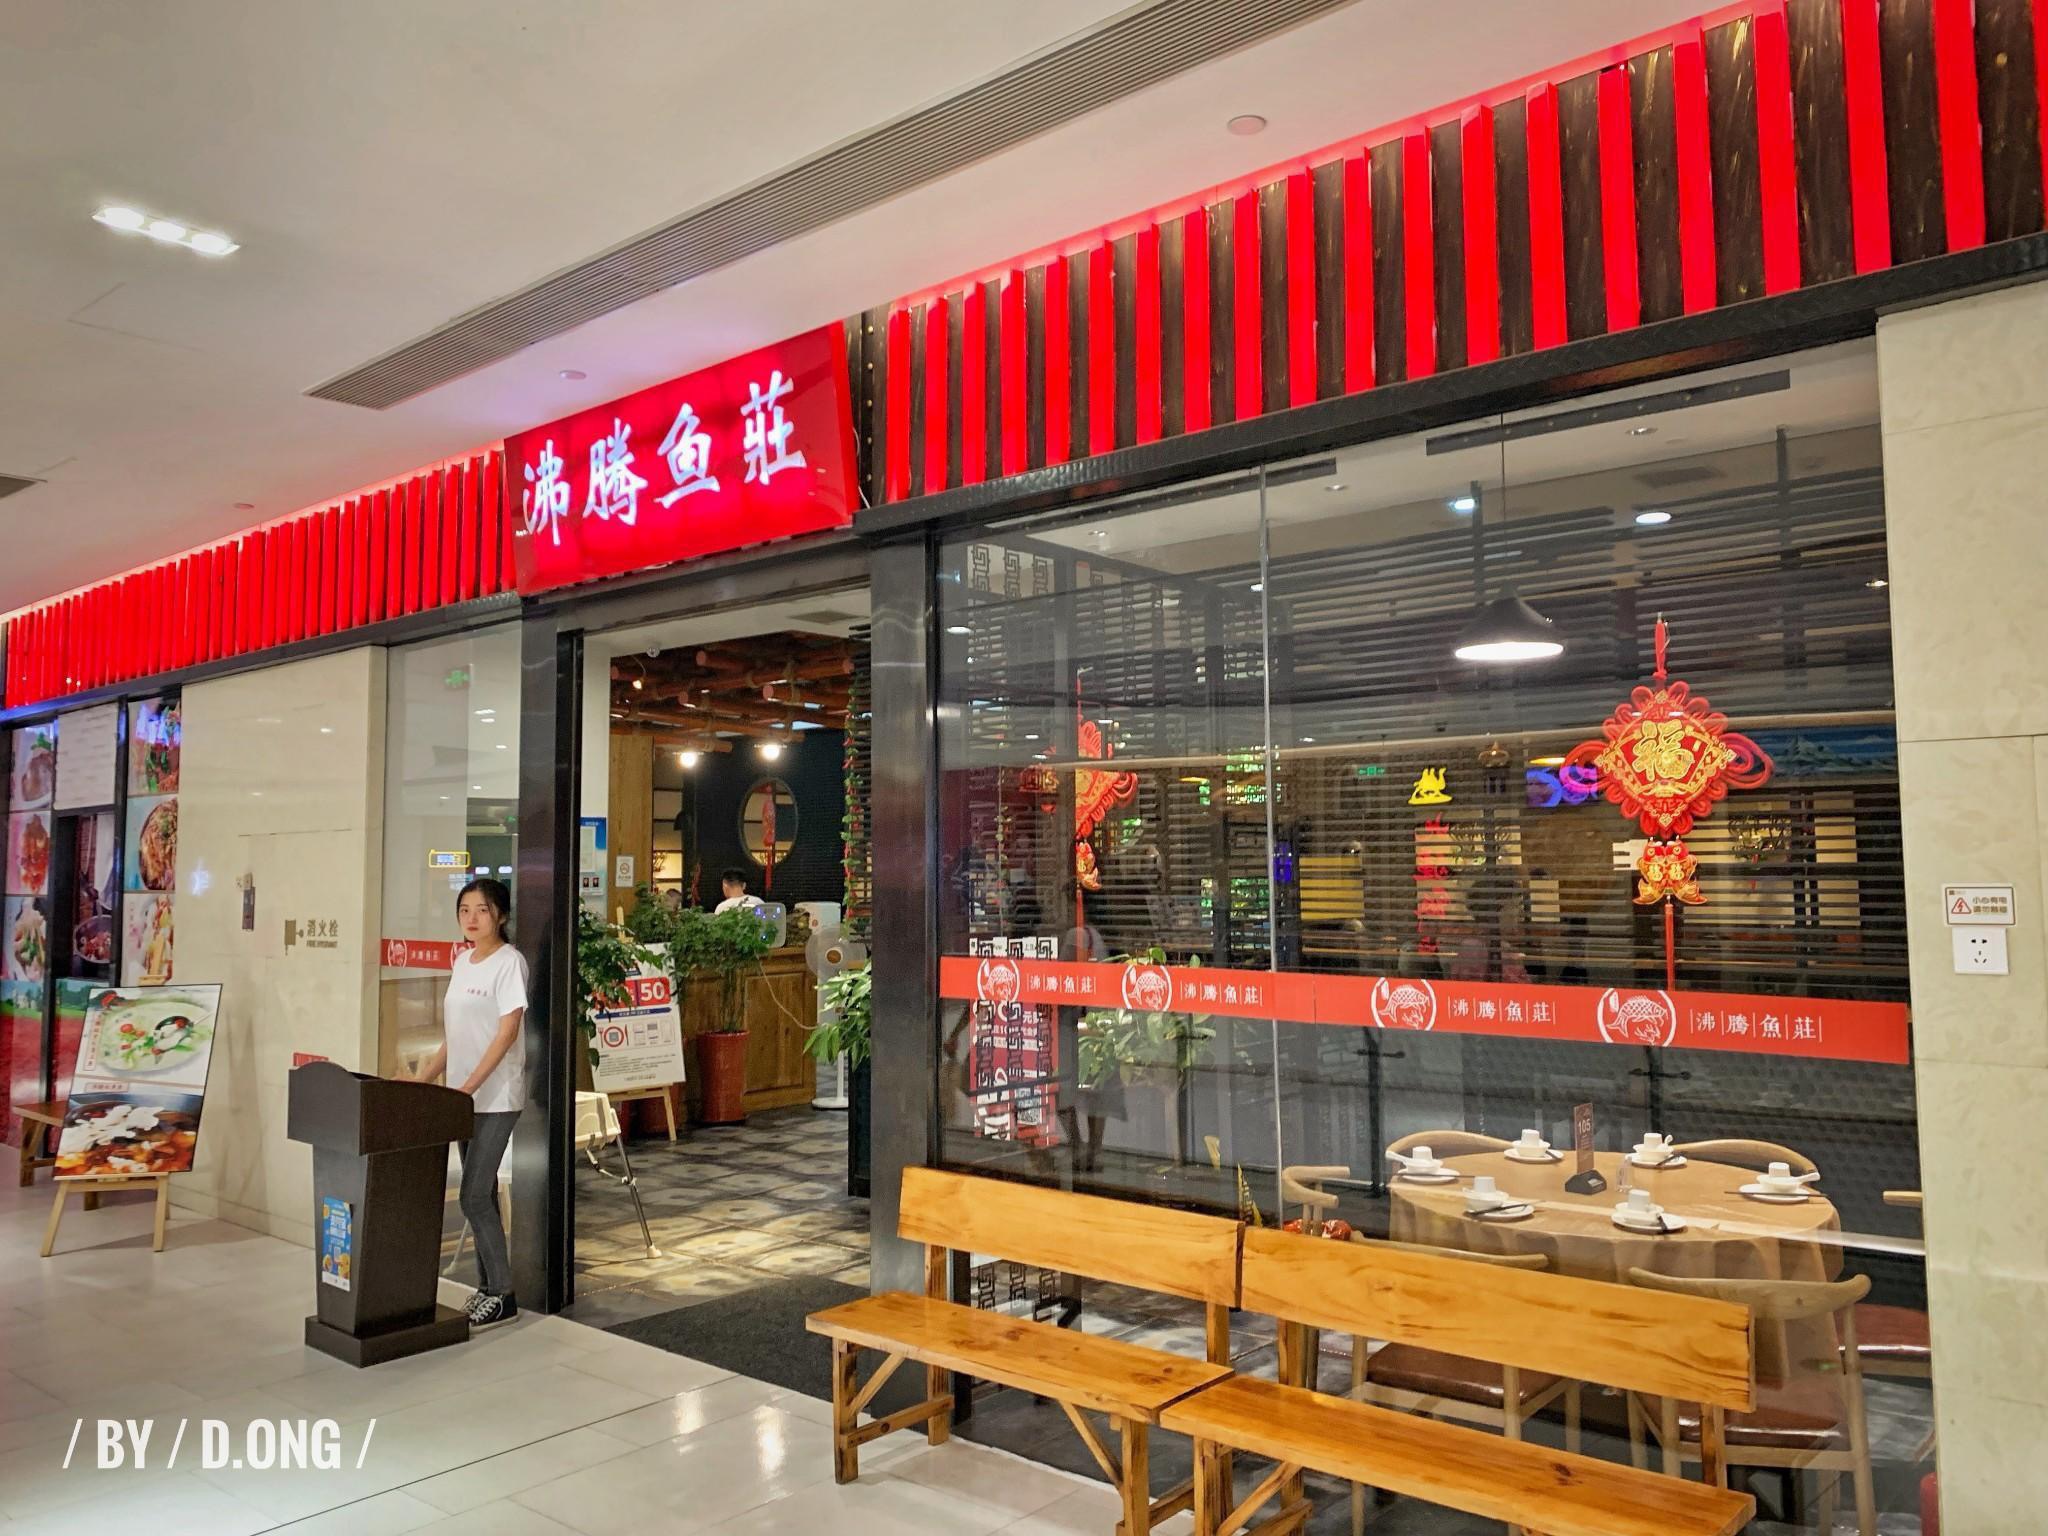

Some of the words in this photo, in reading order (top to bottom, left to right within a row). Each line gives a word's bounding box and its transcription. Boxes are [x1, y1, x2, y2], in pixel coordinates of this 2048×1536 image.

[1632, 719, 1695, 782] 福
[306, 919, 338, 937] 消火栓
[640, 981, 665, 1001] 50
[1578, 1118, 1591, 1134] 105
